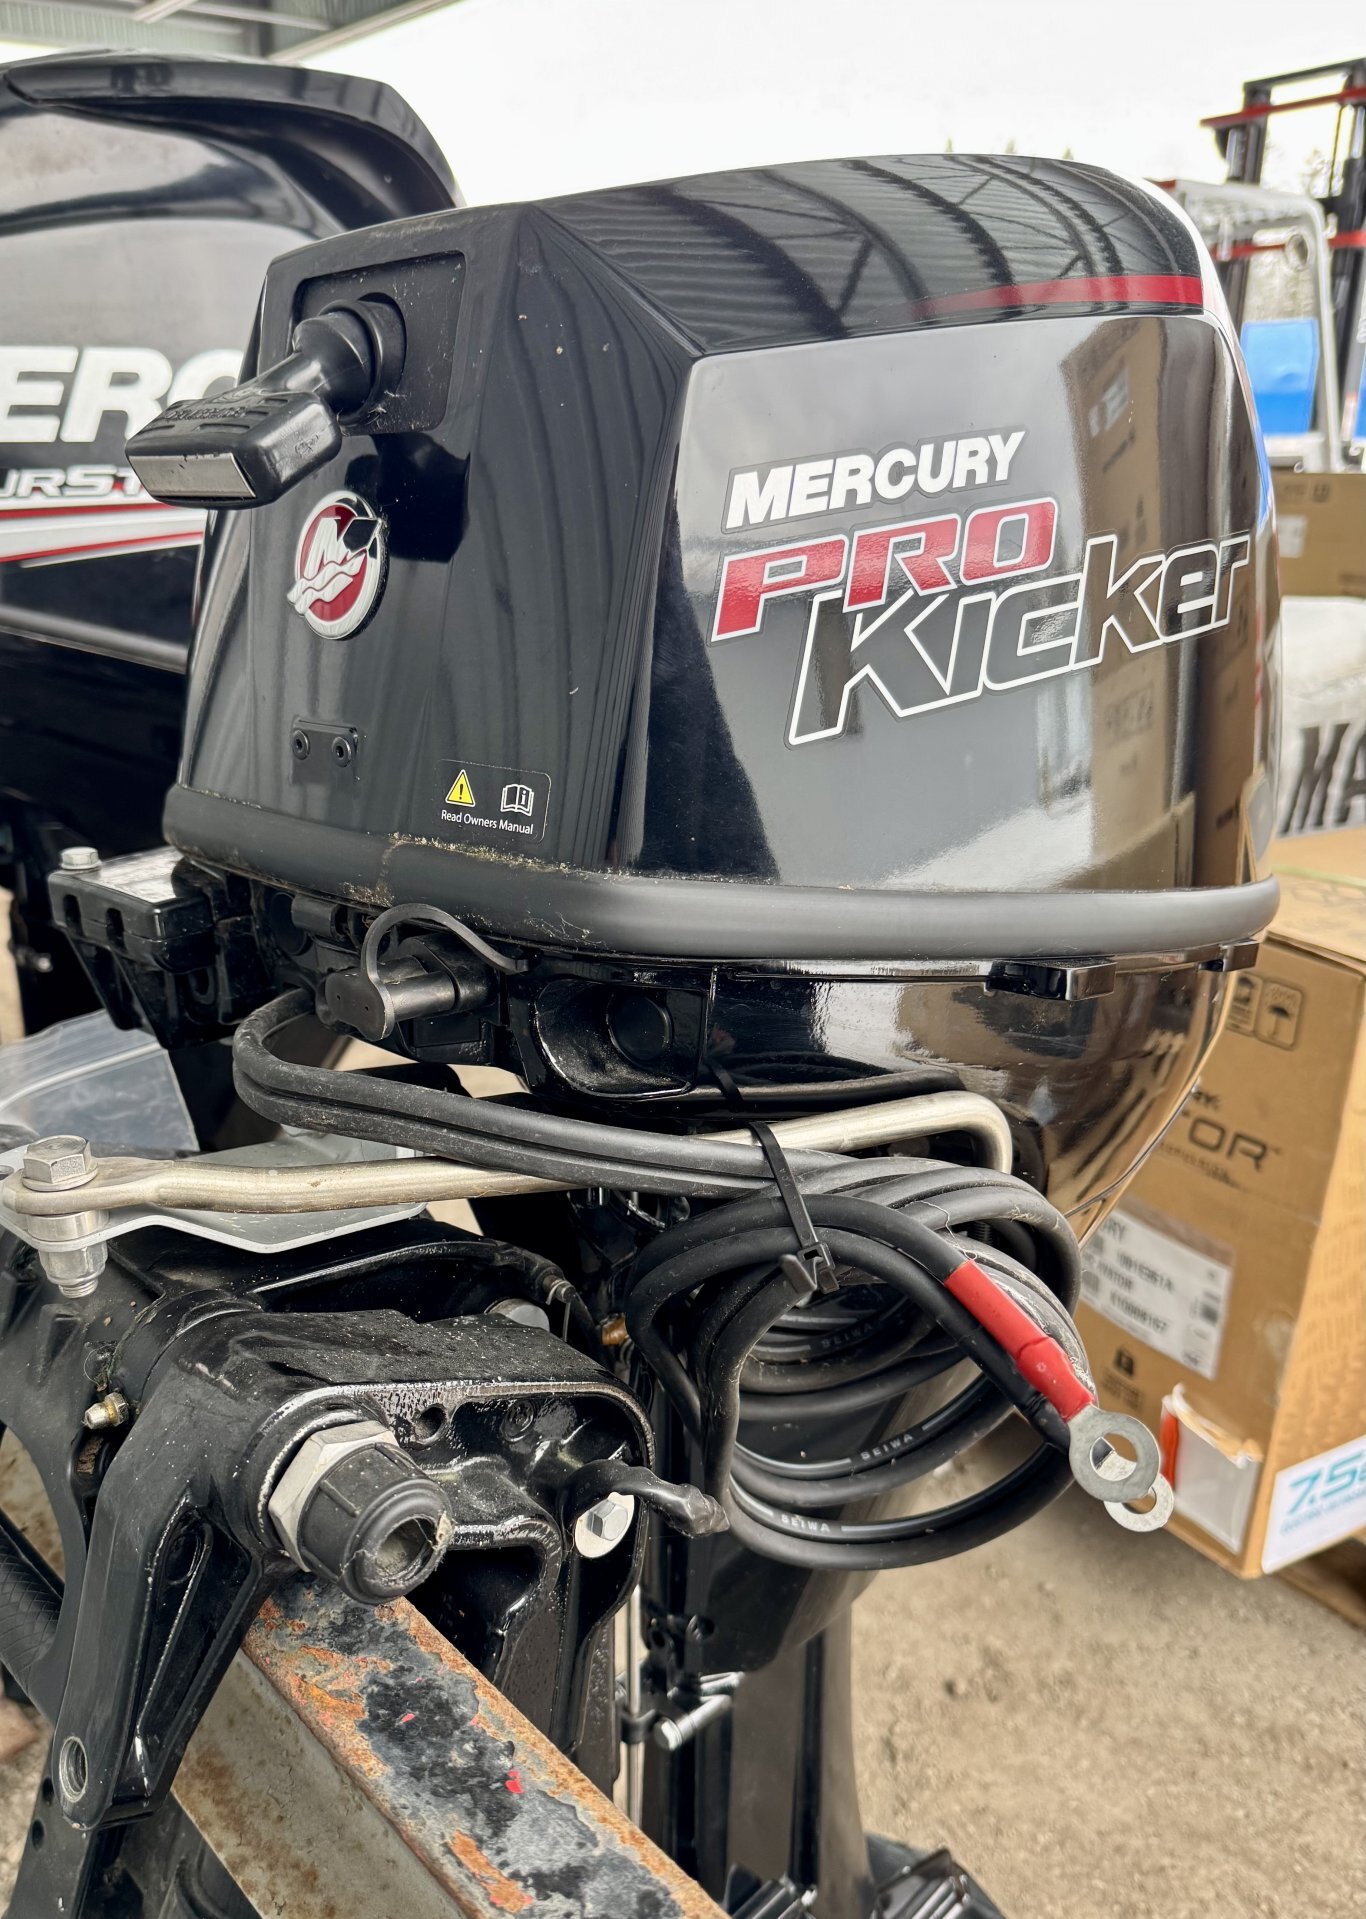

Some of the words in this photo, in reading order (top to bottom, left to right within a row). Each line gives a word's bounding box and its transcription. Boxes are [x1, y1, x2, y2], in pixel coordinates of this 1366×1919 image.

[725, 431, 1025, 529] MERCURY
[710, 497, 1058, 642] PRO
[441, 809, 462, 823] Read
[463, 813, 498, 829] Owners
[498, 819, 534, 835] Manual
[860, 1433, 913, 1461] SEIWA
[781, 1513, 830, 1533] SEIWA
